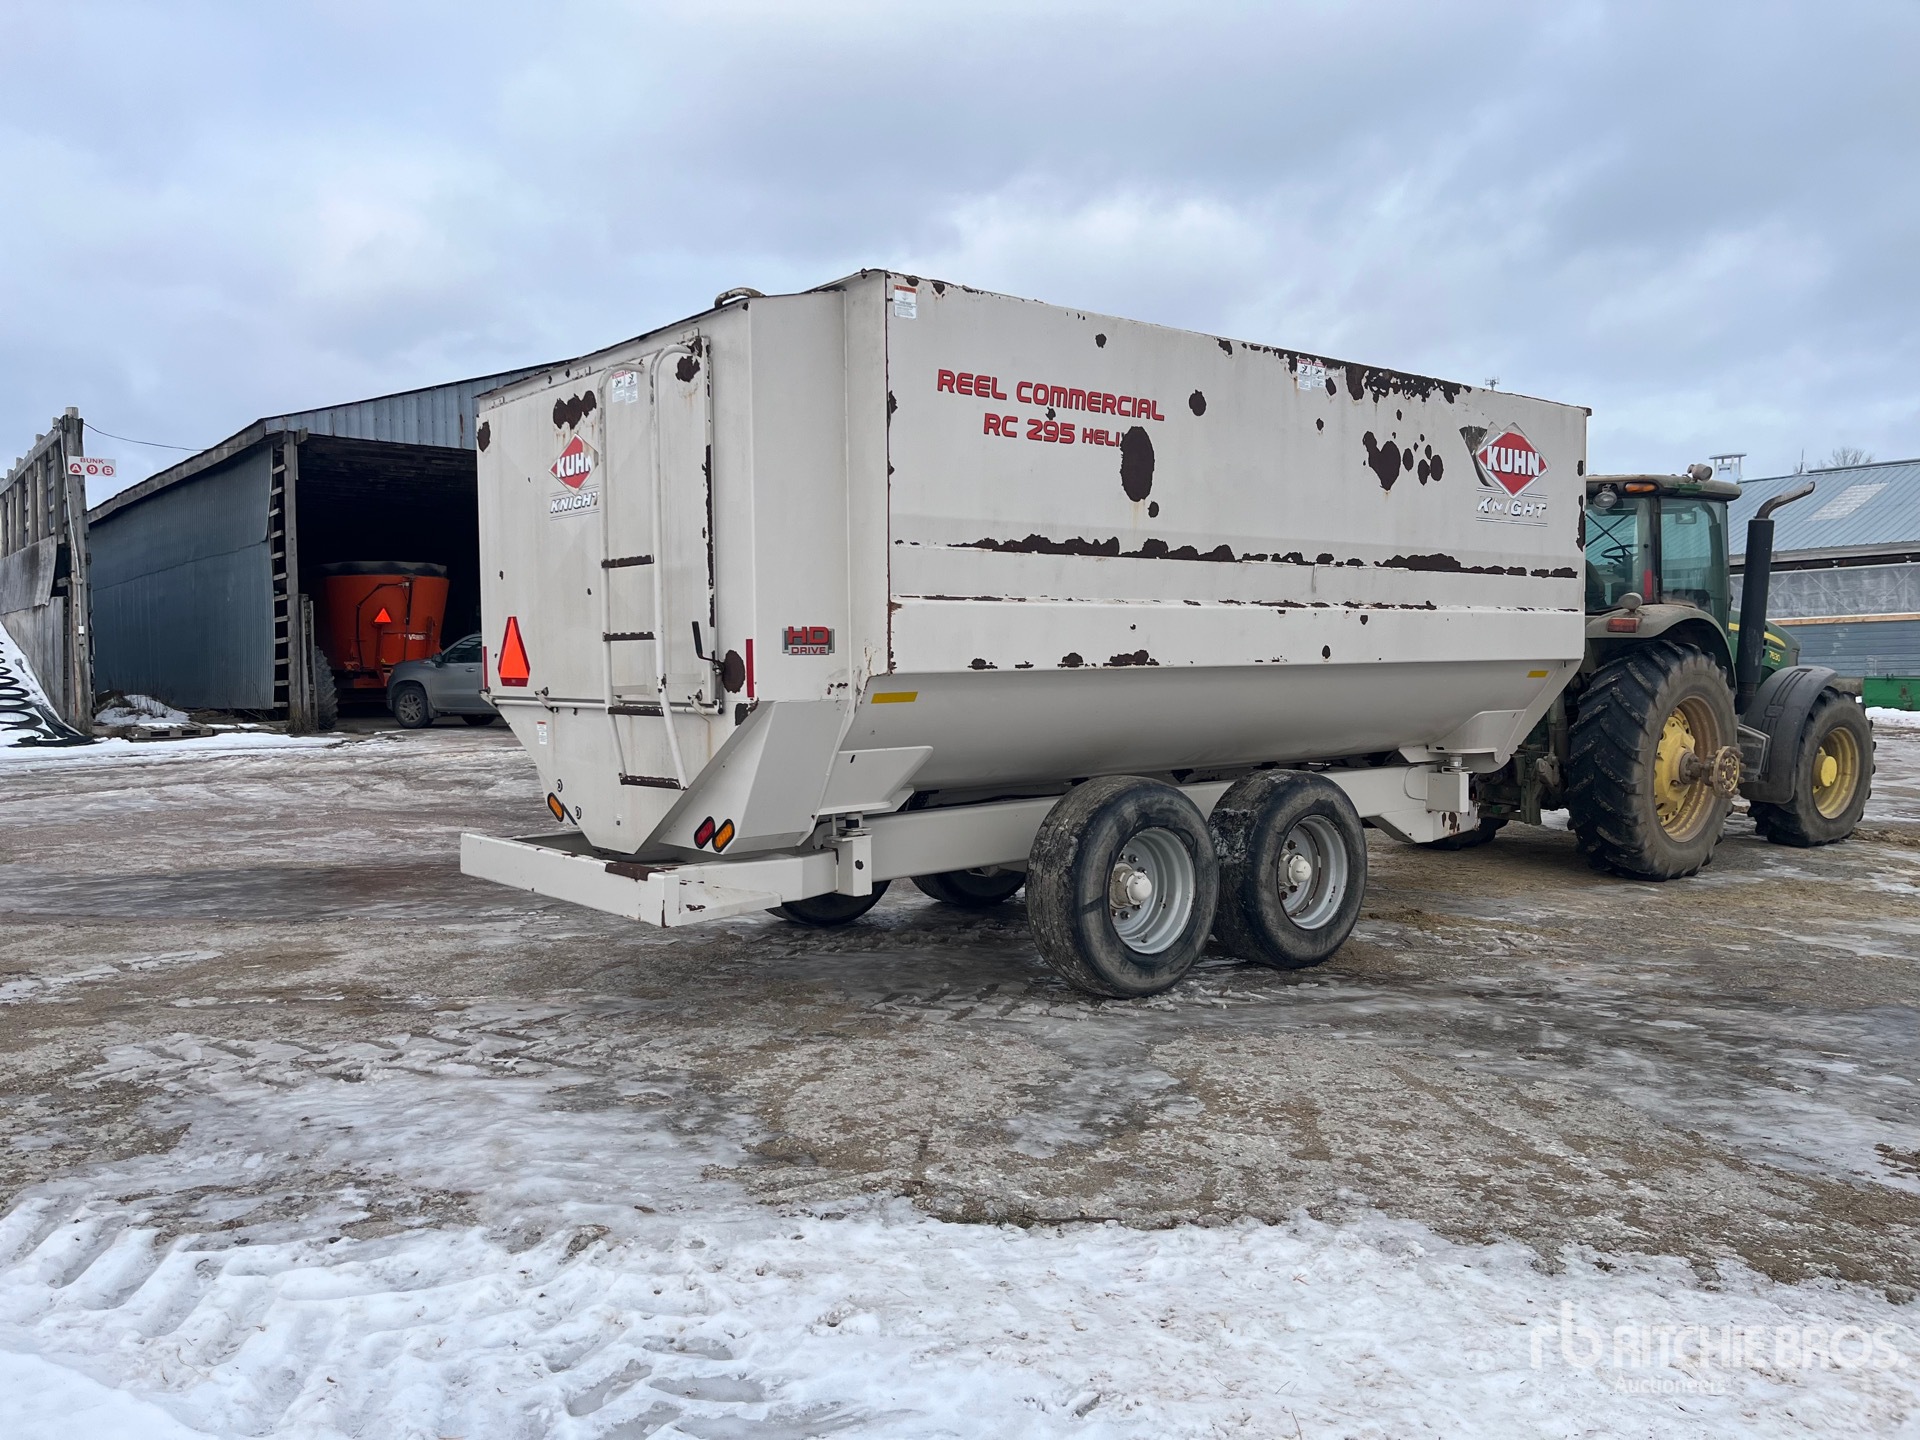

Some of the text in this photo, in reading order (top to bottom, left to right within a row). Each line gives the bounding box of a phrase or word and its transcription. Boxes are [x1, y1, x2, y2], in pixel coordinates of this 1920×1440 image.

[936, 368, 1165, 422] REEL COMMERCIAL
[983, 413, 1125, 448] RC 295 HELI
[80, 457, 105, 465] BUNK
[1486, 445, 1540, 478] KUHN
[1477, 497, 1547, 518] KNIGHT
[787, 626, 830, 645] HD
[791, 646, 827, 654] DRIVE
